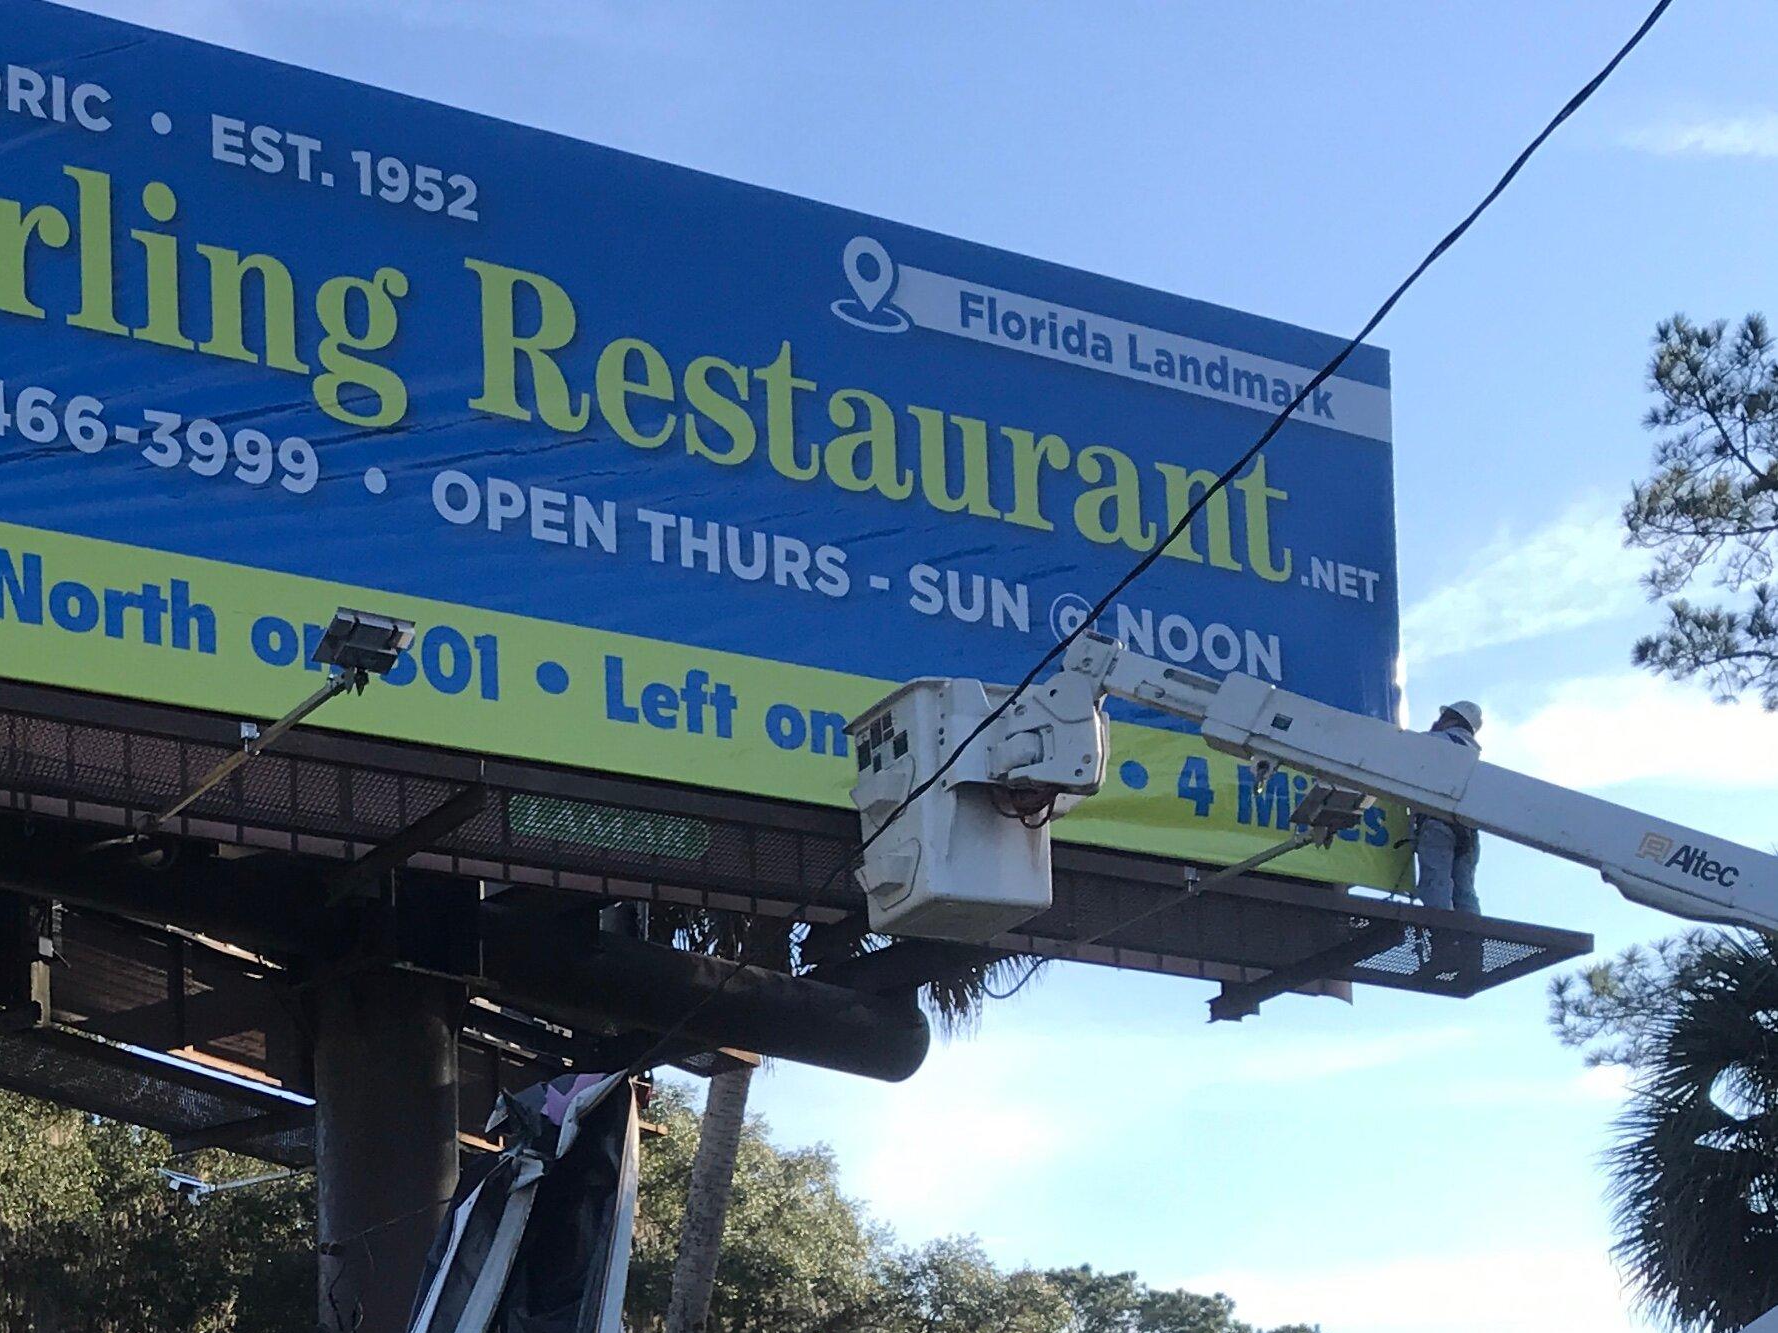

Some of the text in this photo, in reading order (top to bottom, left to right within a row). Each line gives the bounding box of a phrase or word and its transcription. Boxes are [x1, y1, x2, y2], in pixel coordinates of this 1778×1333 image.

[211, 113, 480, 223] EST. 1952
[959, 290, 1113, 363] Florida
[464, 257, 1293, 583] Restaurant
[432, 469, 617, 554] OPEN
[637, 506, 850, 599] THURS
[908, 562, 1030, 634] SUN
[1116, 602, 1283, 682] NOON
[1301, 555, 1380, 602] .NET
[606, 655, 737, 740] Left
[765, 706, 849, 758] on
[1177, 756, 1390, 847] 4 Mis
[1665, 845, 1740, 888] Altec
